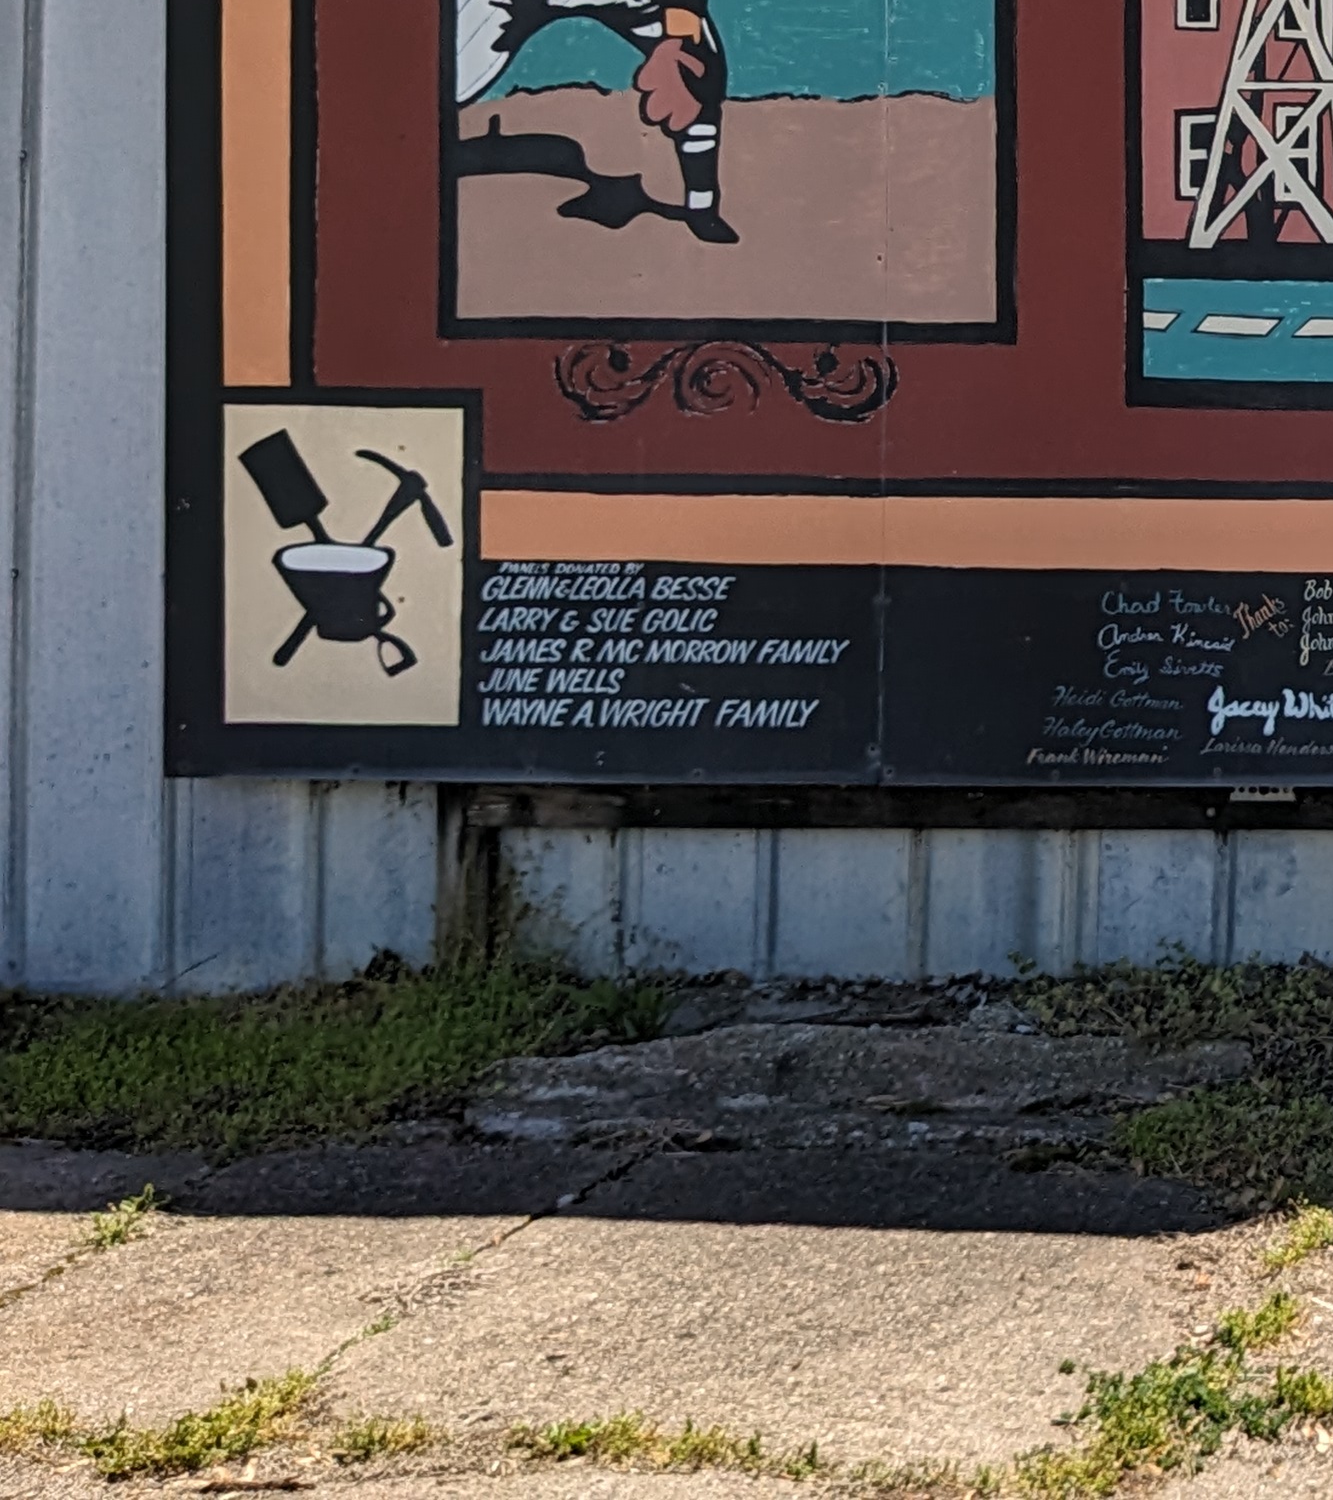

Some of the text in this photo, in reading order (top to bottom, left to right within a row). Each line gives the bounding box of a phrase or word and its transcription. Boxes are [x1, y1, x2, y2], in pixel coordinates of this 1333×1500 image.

[499, 562, 645, 575] PANELS DONATED BY
[651, 576, 736, 601] BESSE
[1304, 578, 1333, 602] Bob
[1101, 591, 1160, 615] Chad
[478, 607, 719, 633] LARRY & SUE GOLIC
[480, 638, 568, 664] JAMES
[597, 639, 645, 664] MC
[645, 639, 757, 665] MORROW
[755, 640, 849, 665] FAMILY
[1103, 649, 1150, 685] Emily
[478, 669, 626, 694] JUNE WELLS
[481, 698, 570, 727] WAYNE
[600, 699, 711, 727] WRIGHT
[714, 699, 819, 728] FAMILY
[1026, 747, 1081, 765] Frank
